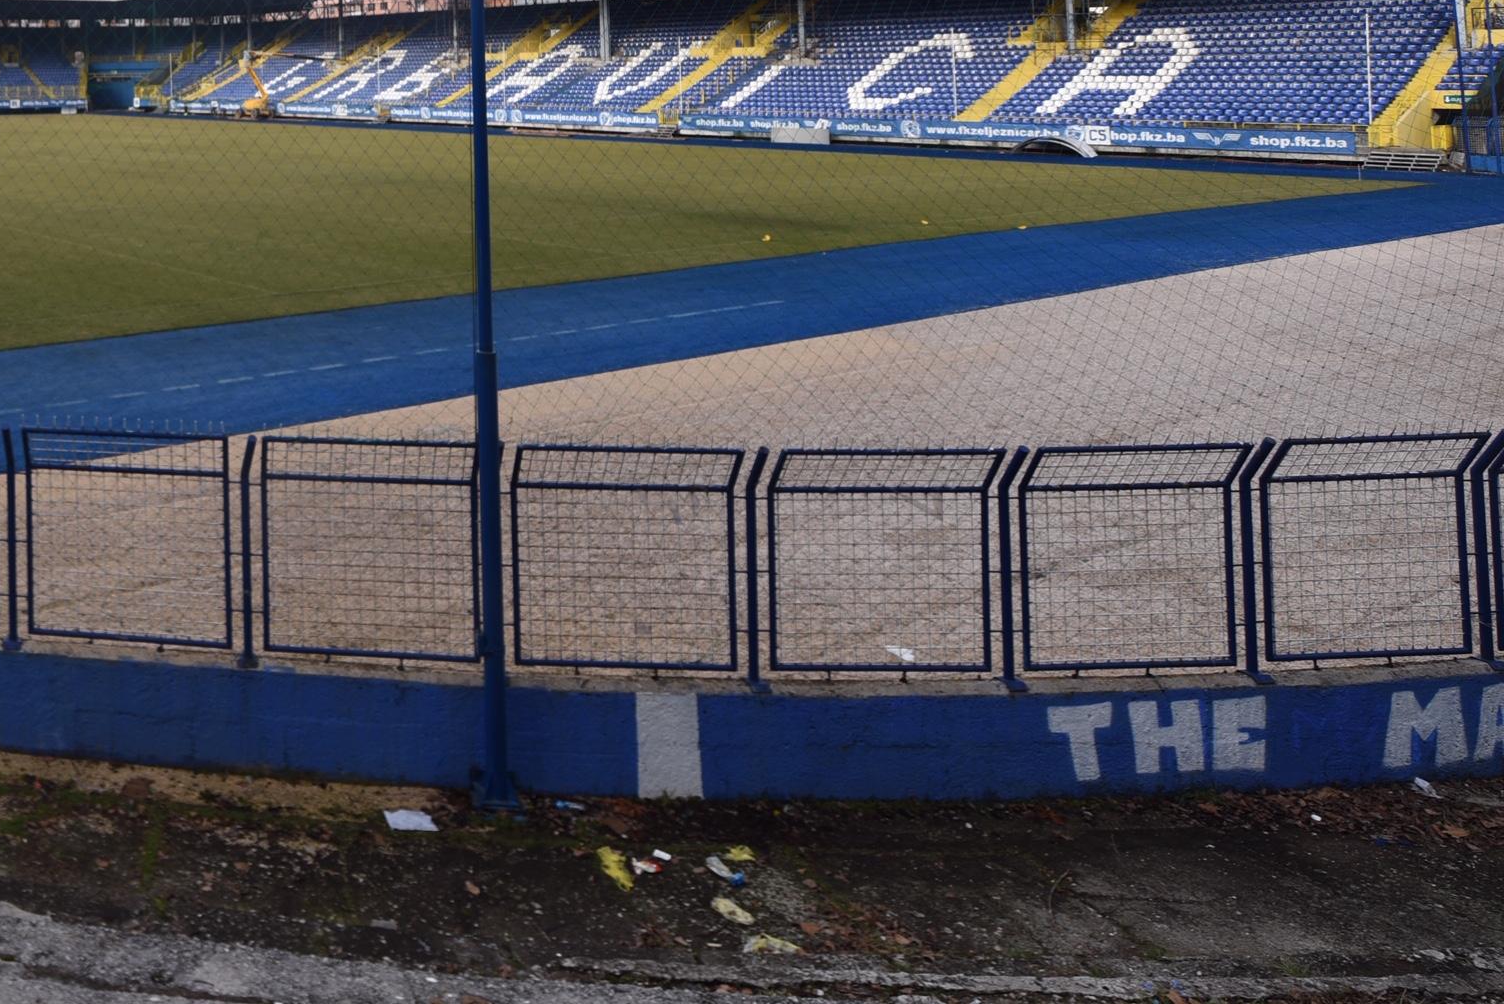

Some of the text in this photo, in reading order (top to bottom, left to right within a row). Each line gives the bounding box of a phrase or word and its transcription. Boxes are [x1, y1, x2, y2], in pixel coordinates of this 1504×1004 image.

[696, 118, 744, 129] shop.fkz.ba
[836, 122, 892, 133] shop.fkz.ba
[926, 126, 1060, 139] www.fkzeljeznicar.ba
[1110, 130, 1347, 150] hop.fkz.ba shop.fkz.ba
[1047, 696, 1167, 783] THE
